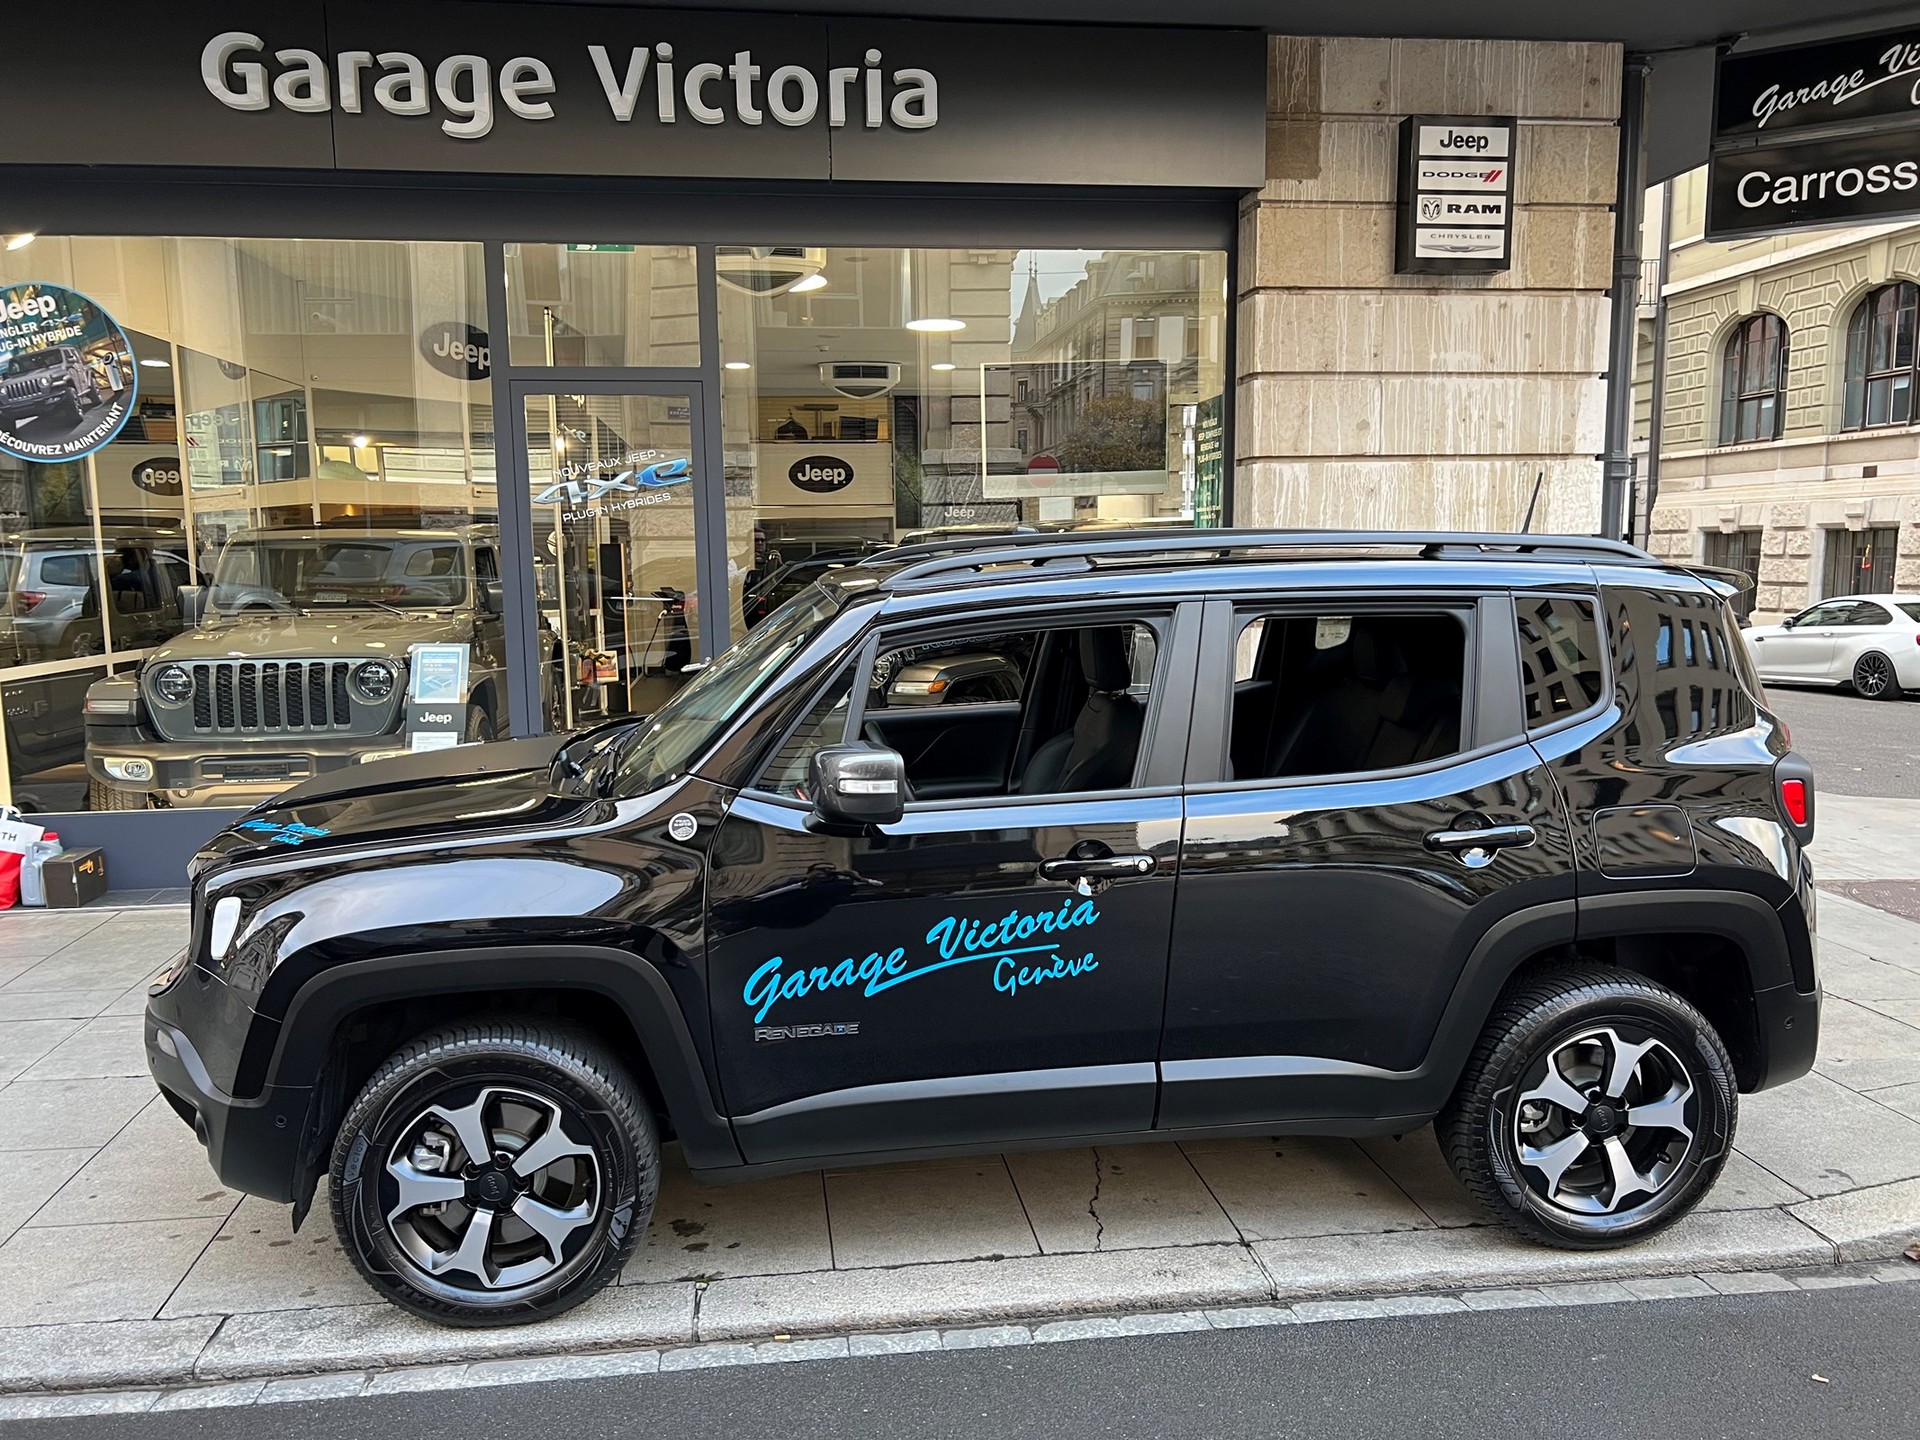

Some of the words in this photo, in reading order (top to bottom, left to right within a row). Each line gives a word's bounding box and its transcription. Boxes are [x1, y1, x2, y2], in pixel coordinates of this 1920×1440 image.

[200, 31, 557, 140] Garage
[587, 41, 938, 130] Victoria
[1752, 68, 1866, 129] Garage
[1439, 130, 1489, 152] Jeep
[1737, 161, 1918, 208] Carross
[1447, 204, 1502, 214] RAM
[0, 322, 38, 339] NGLER
[0, 336, 31, 352] UG-IN
[32, 325, 83, 345] HYBRIDE
[433, 332, 490, 370] Jeep
[0, 429, 62, 455] ÉCOUVREZ
[62, 401, 124, 453] MAINTENANT
[552, 456, 622, 478] NOUVEAUX
[625, 449, 657, 465] JEEP
[797, 463, 846, 484] Jeep
[610, 491, 672, 512] HYBRIDES
[944, 506, 975, 519] Jeep
[419, 711, 453, 725] Jeep
[743, 946, 908, 1025] Garage
[925, 898, 1101, 960] Victoria
[993, 952, 1100, 997] Genève
[754, 1021, 860, 1042] RENEGADE
